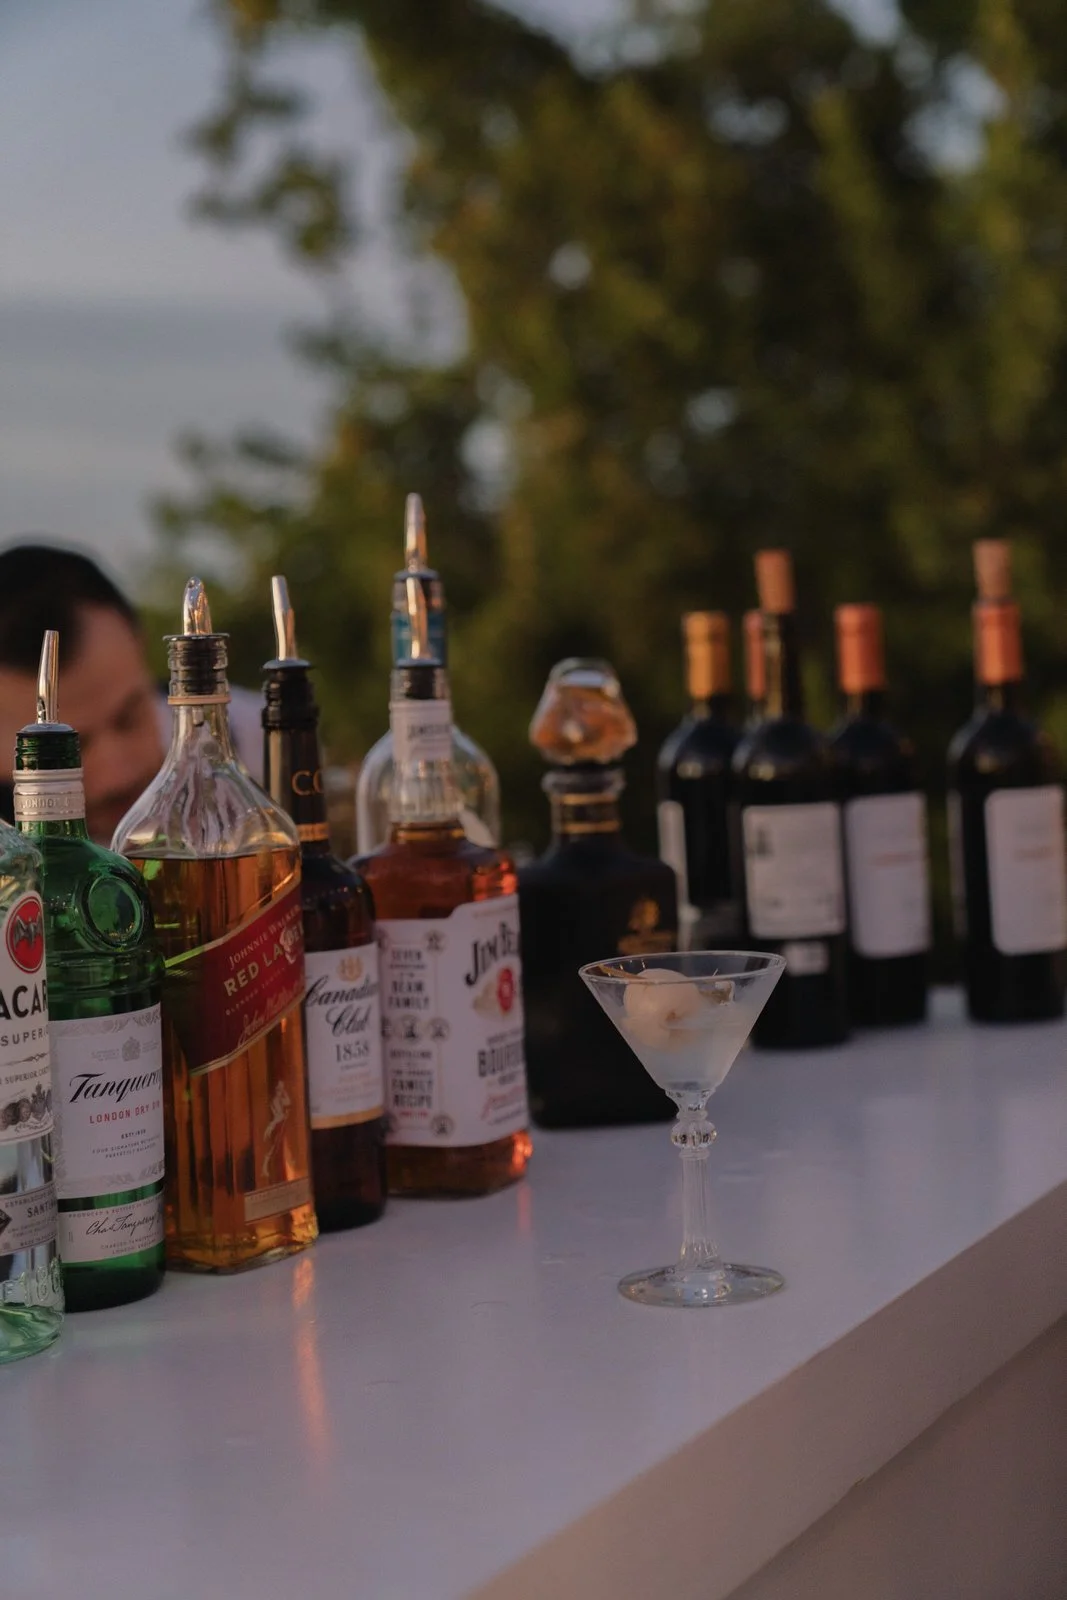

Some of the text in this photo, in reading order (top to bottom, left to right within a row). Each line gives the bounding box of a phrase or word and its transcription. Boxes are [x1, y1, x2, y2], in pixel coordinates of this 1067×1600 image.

[227, 933, 268, 971] JOHNNIE
[223, 961, 260, 997] RED
[89, 1109, 131, 1124] LONDON
[135, 1104, 149, 1116] DRY
